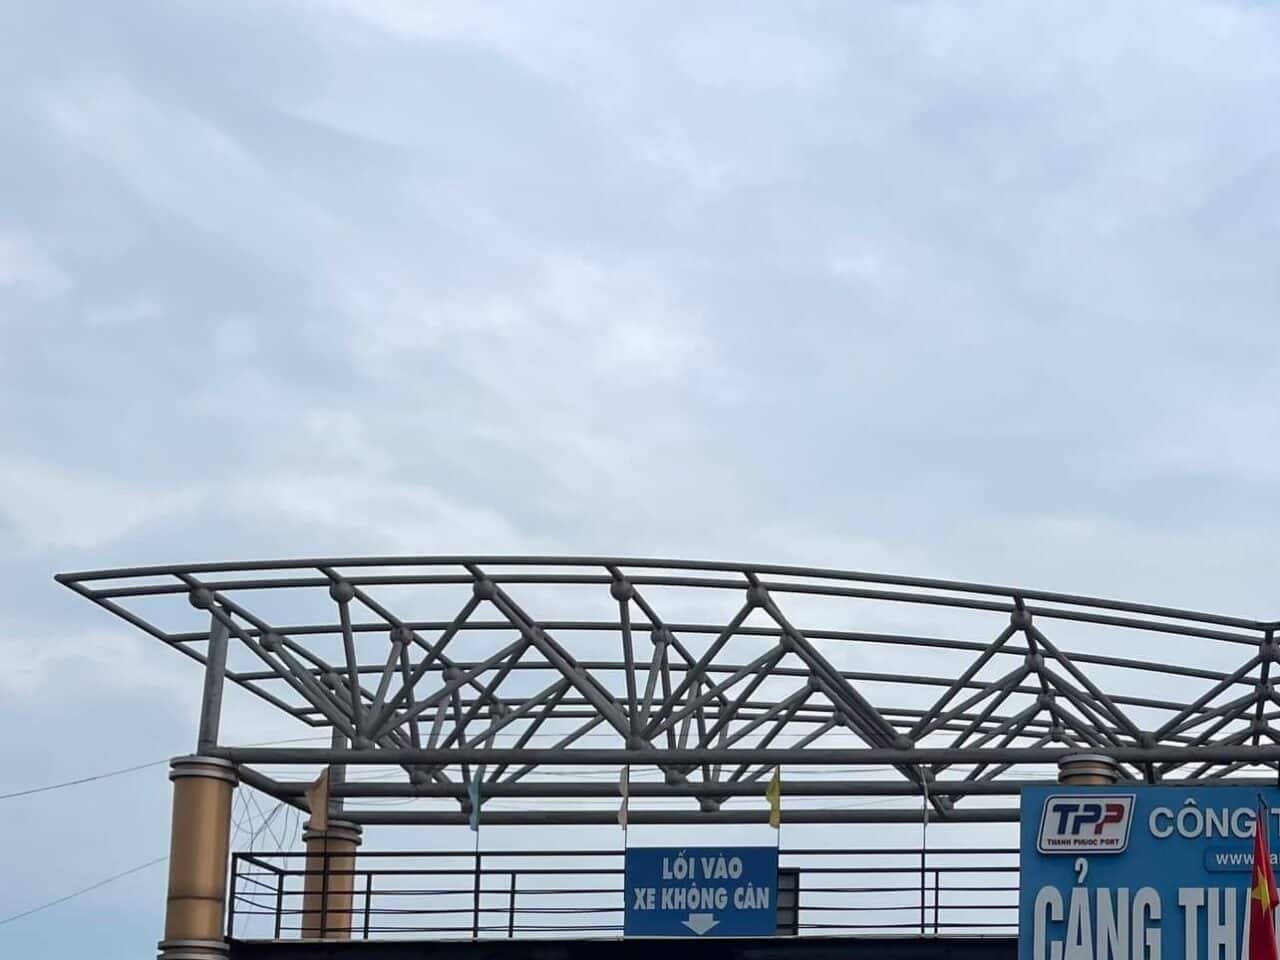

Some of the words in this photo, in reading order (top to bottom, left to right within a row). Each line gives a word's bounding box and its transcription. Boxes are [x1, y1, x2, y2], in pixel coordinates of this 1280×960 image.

[1052, 803, 1125, 835] TPP
[1148, 797, 1257, 839] CÔNG
[662, 849, 696, 880] LỐI
[700, 852, 743, 880] VÀO
[633, 887, 657, 910] XE
[661, 882, 729, 910] KHÔNG
[733, 882, 770, 910] CÂN
